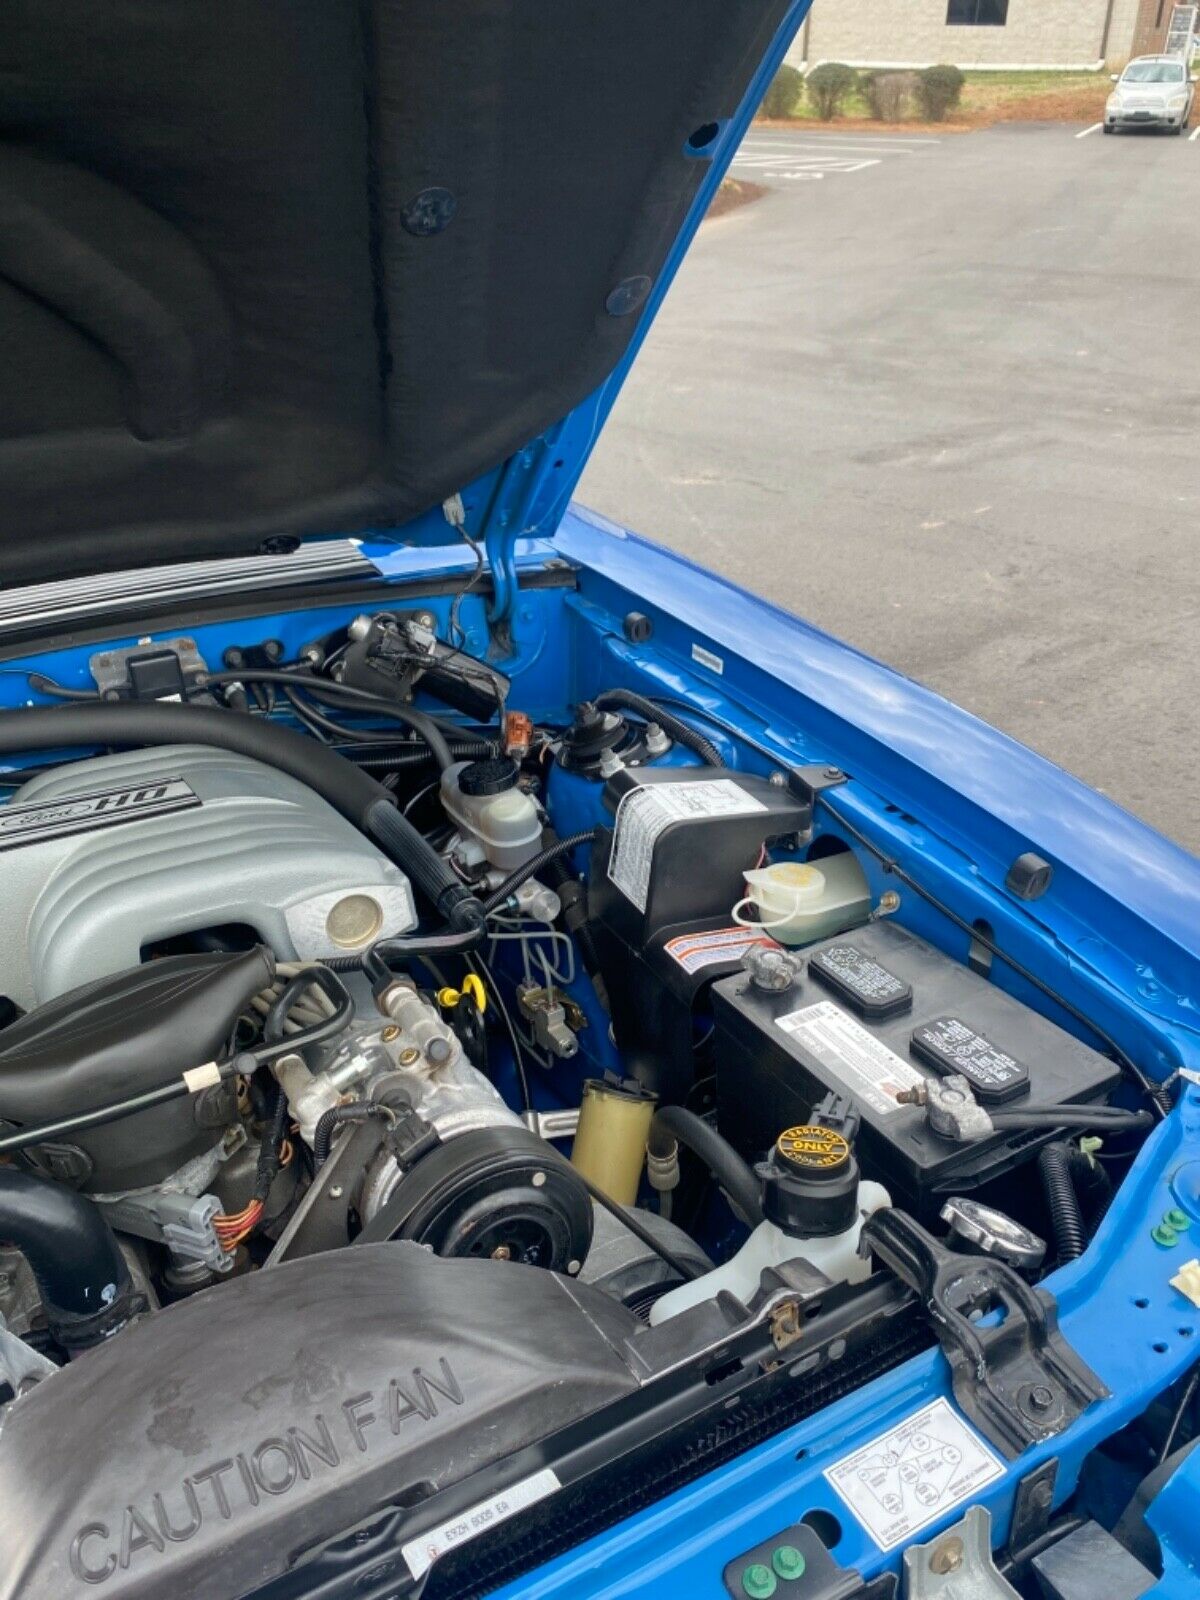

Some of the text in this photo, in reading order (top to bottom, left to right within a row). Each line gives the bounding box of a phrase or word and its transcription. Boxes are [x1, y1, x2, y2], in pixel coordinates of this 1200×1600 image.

[793, 1140, 833, 1152] ONLY
[69, 1356, 465, 1585] CAUTION FAN
